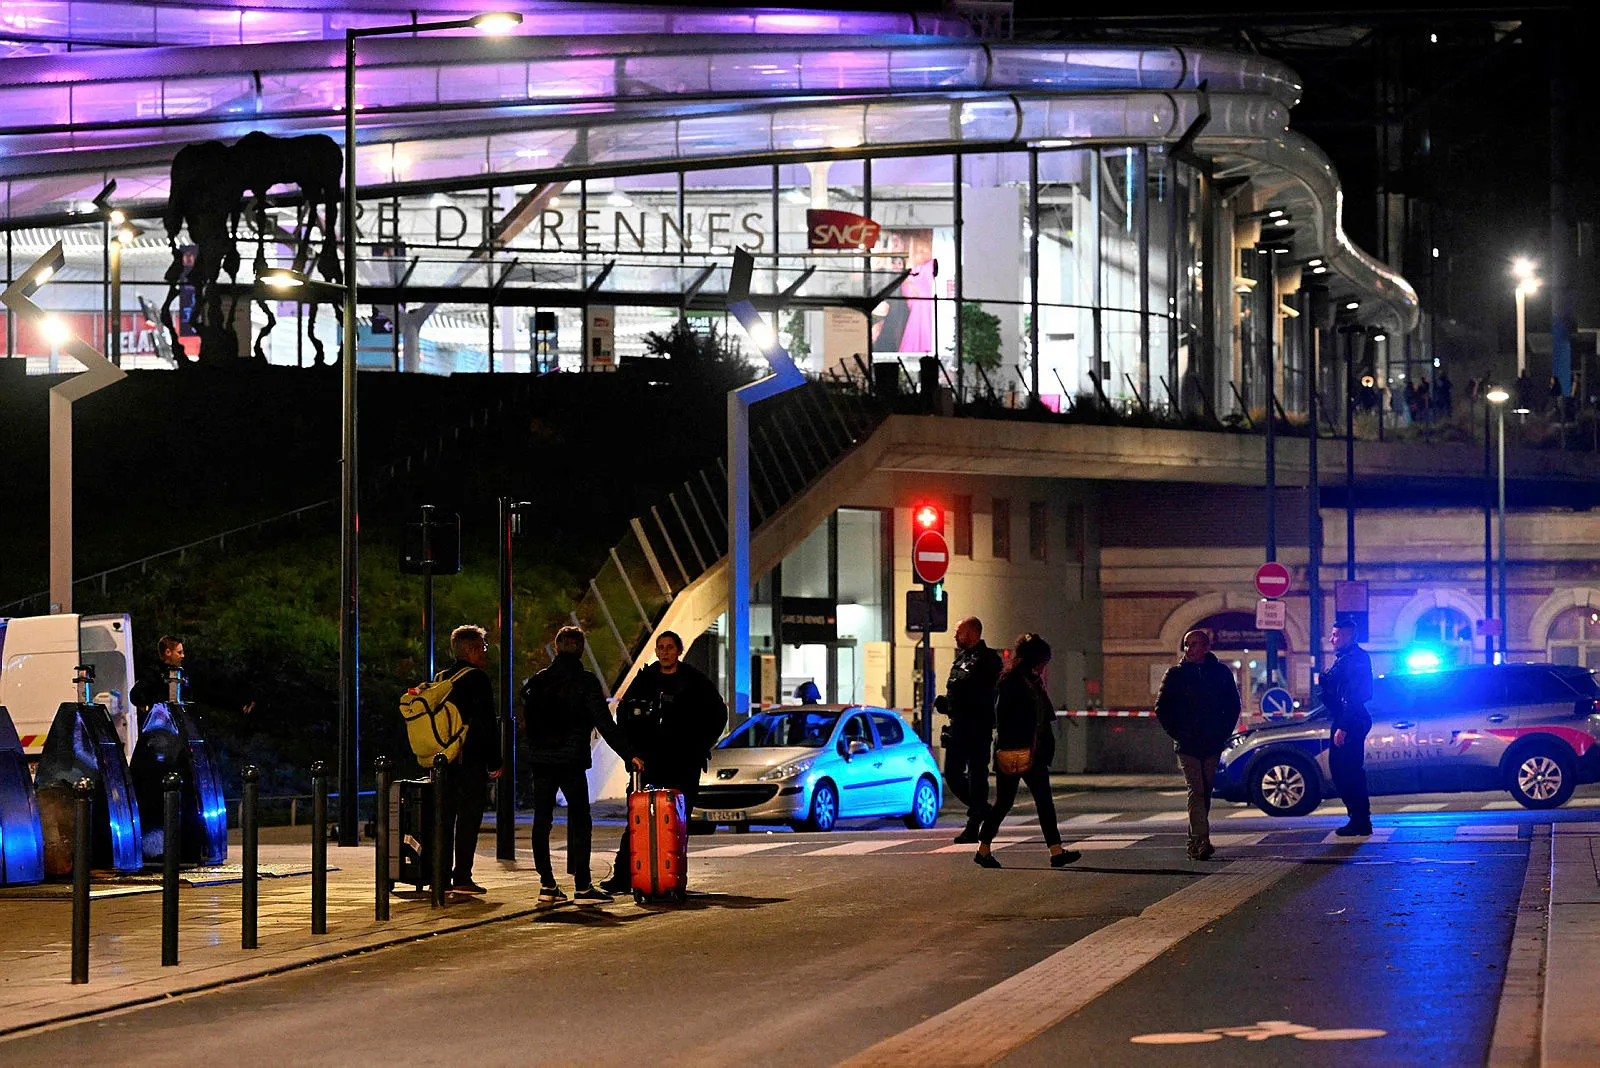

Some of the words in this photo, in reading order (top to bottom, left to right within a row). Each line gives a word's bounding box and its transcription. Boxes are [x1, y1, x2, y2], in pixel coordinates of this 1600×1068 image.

[436, 206, 505, 245] DE
[540, 209, 764, 250] RENNES
[811, 221, 877, 245] SNCF
[1365, 748, 1443, 760] ATIONALE
